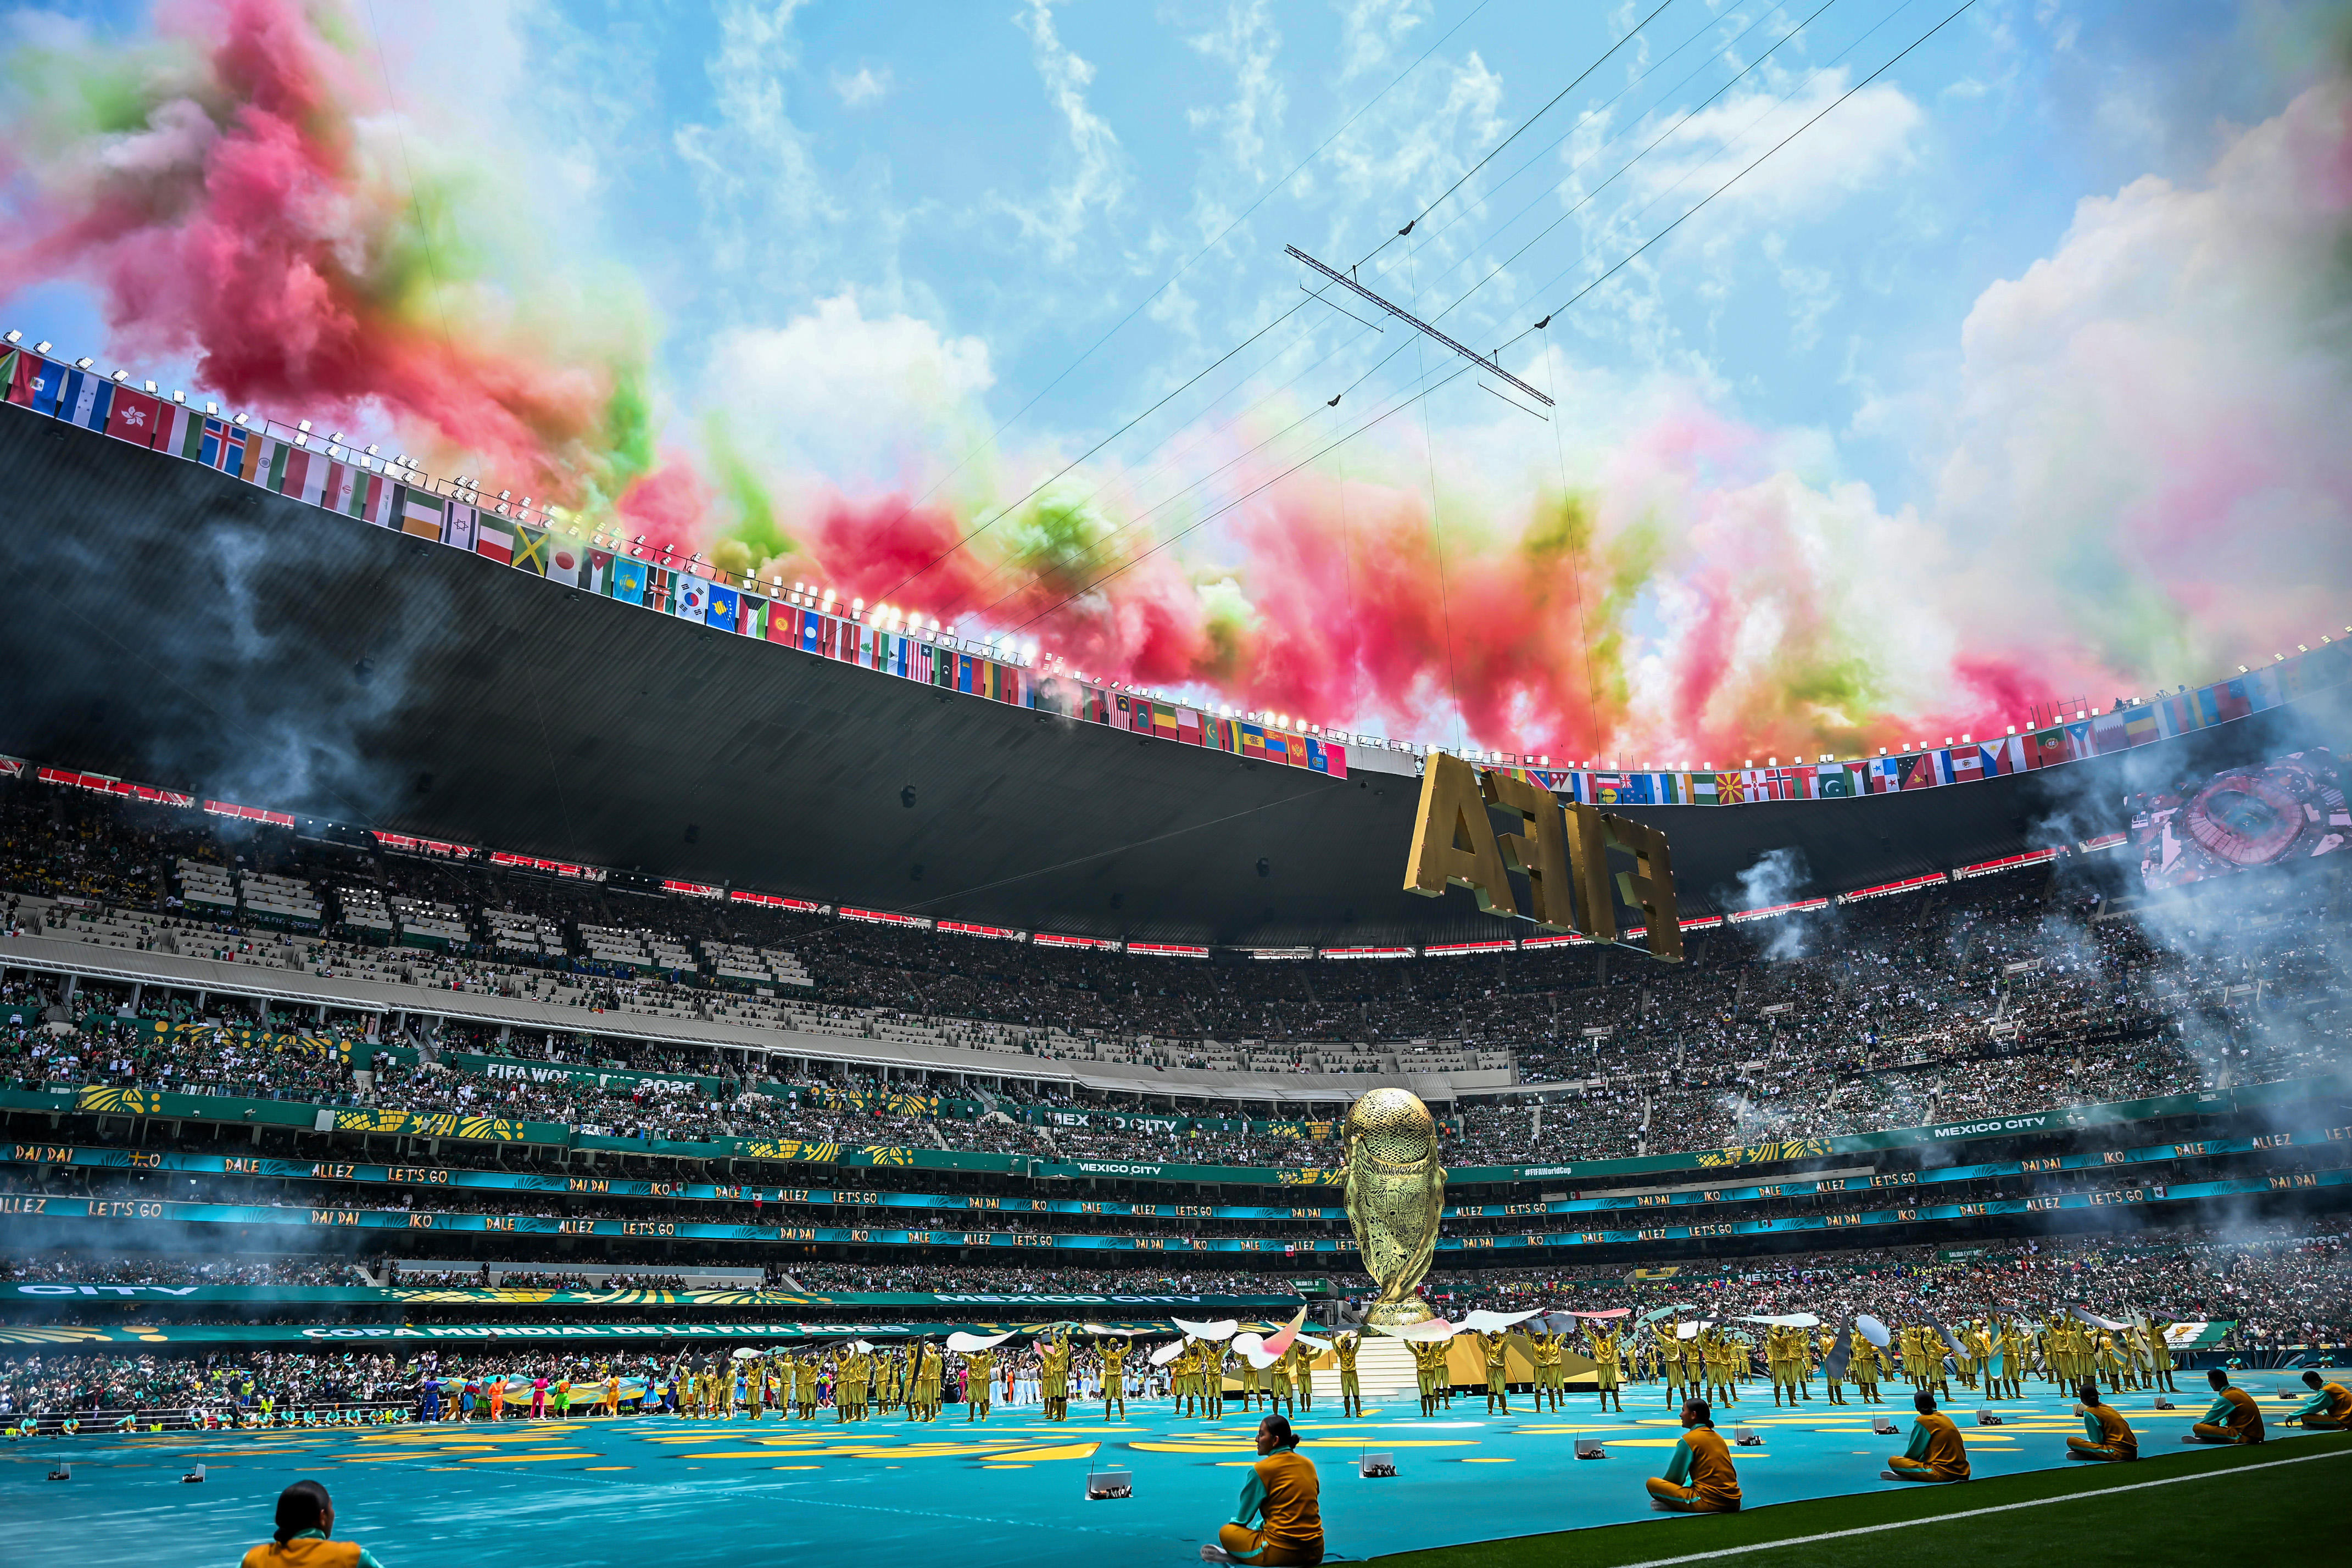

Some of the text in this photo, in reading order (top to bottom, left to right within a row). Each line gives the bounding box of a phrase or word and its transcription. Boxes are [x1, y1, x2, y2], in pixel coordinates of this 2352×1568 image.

[487, 1064, 527, 1081] FIFA
[1935, 1117, 2046, 1137] MEXICO CITY
[2253, 1134, 2293, 1148] ALLEZ
[16, 1146, 73, 1162] DAI DAI
[2175, 1143, 2206, 1156] DALE
[2104, 1152, 2124, 1163] IKO
[226, 1158, 259, 1173] DALE
[1079, 1163, 1161, 1175] MEXICO CITY
[2022, 1158, 2060, 1171] DAI DAI
[312, 1164, 354, 1178] ALLEZ
[389, 1168, 447, 1183] LET'S GO
[1525, 1167, 1571, 1176] #FIFAWorldCup
[1869, 1173, 1915, 1186] LET'S GO
[2270, 1174, 2316, 1188] DAI DAI
[570, 1179, 609, 1192] DAI DAI
[651, 1183, 670, 1195] IKO
[1816, 1180, 1846, 1192] ALLEZ
[716, 1186, 740, 1198] DALE
[778, 1190, 808, 1201] ALLEZ
[1704, 1191, 1720, 1201] IKO
[1759, 1186, 1782, 1197] DALE
[834, 1192, 876, 1203] LET'S GO
[969, 1197, 999, 1208] DAI DAI
[1638, 1195, 1669, 1205] DAI DAI
[2088, 1190, 2142, 1205] LET'S GO
[89, 1201, 161, 1218] LET'S GO
[1032, 1200, 1046, 1210] IKO
[1082, 1203, 1101, 1213] DALE
[1506, 1203, 1546, 1214] LET'S GO
[2027, 1198, 2060, 1210] ALLEZ
[1132, 1205, 1156, 1215] ALLEZ
[1176, 1206, 1211, 1216] LET'S GO
[1292, 1208, 1320, 1218] DAI DAI
[1456, 1207, 1482, 1217] ALLEZ
[1898, 1210, 1915, 1220] IKO
[1960, 1204, 1987, 1216] DALE
[312, 1210, 359, 1225] DAI DAI
[409, 1214, 432, 1227] IKO
[1826, 1214, 1860, 1226] DAI DAI
[487, 1217, 515, 1230] DALE
[559, 1221, 594, 1234] ALLEZ
[624, 1223, 673, 1235] LET'S GO
[781, 1228, 815, 1240] DAI DAI
[852, 1230, 868, 1241] IKO
[1638, 1229, 1666, 1240] ALLEZ
[1689, 1224, 1731, 1236] LET'S GO
[909, 1232, 930, 1243] DALE
[964, 1234, 990, 1245] ALLEZ
[1013, 1235, 1052, 1246] LET'S GO
[1463, 1238, 1493, 1247] DAI DAI
[1528, 1236, 1543, 1245] IKO
[1582, 1233, 1604, 1243] DALE
[1136, 1239, 1163, 1249] DAI DAI
[1194, 1240, 1207, 1250] IKO
[1241, 1241, 1260, 1250] DALE
[1294, 1241, 1314, 1251] LLEZ
[18, 1285, 199, 1295] CITY
[302, 1328, 425, 1337] COPA
[427, 1327, 609, 1336] MUNDIAL
